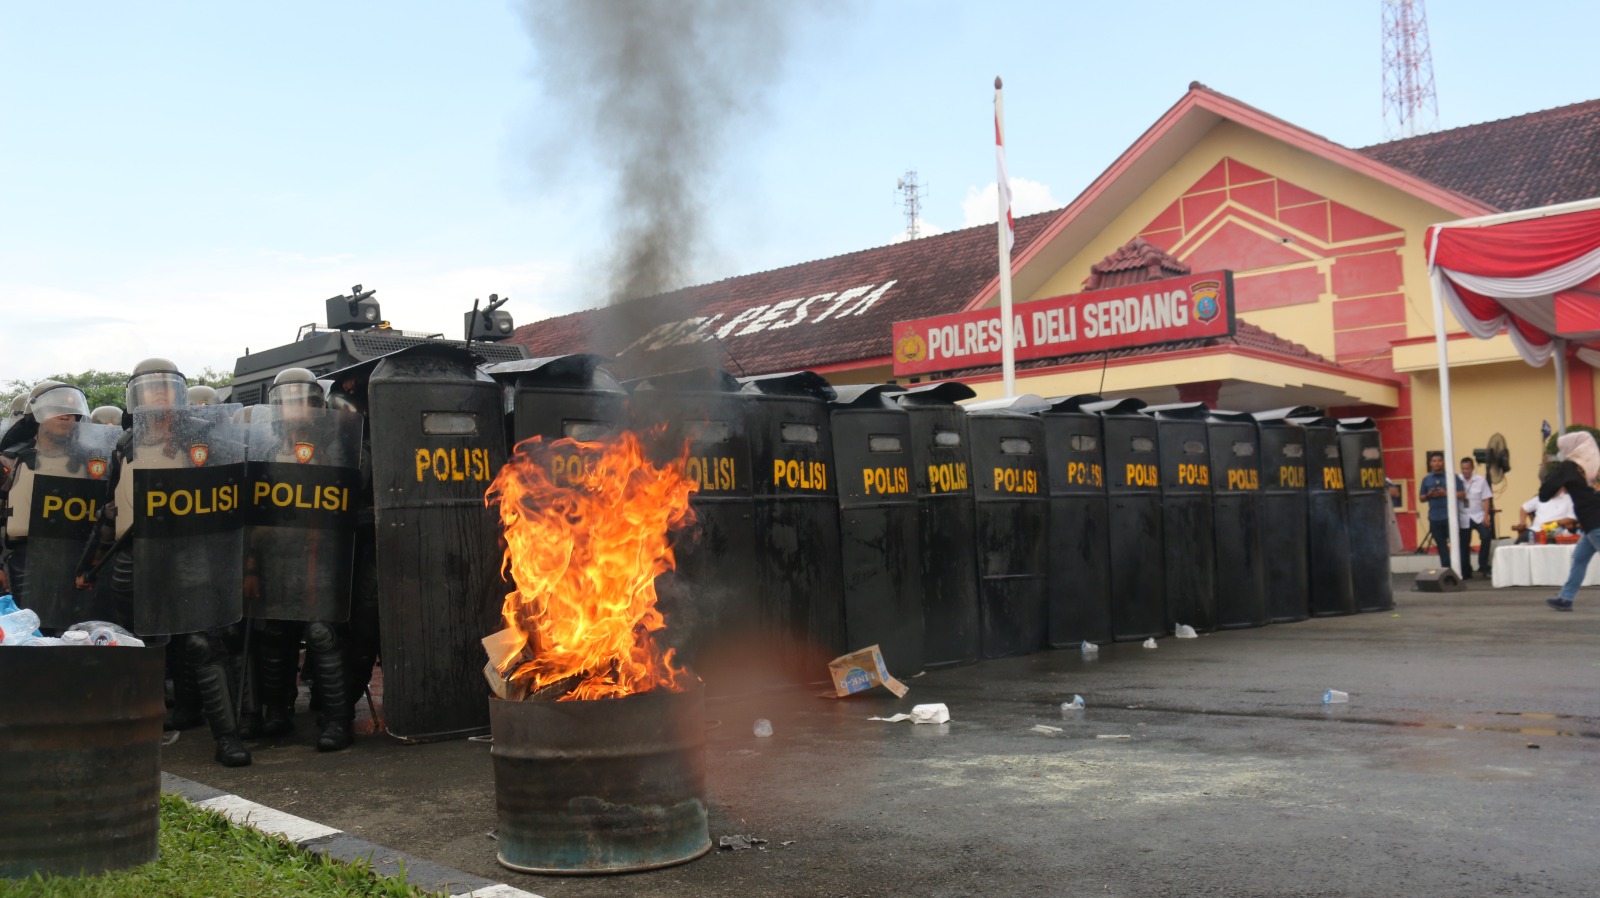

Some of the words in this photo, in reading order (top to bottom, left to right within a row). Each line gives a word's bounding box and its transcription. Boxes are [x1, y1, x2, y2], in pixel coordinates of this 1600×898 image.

[928, 316, 1027, 360] POLRESA
[1032, 306, 1077, 346] DELI
[1083, 289, 1189, 339] SERDANG
[415, 447, 491, 482] POLISI
[685, 456, 736, 491] OLISI
[773, 458, 827, 491] POLISI
[928, 462, 968, 494] POLISI
[993, 467, 1038, 494] POLISI
[1067, 461, 1103, 488] POLISI
[254, 481, 348, 511] POLISI
[863, 467, 909, 495] POLISI
[42, 495, 98, 522] POL
[146, 485, 238, 517] POLISI
